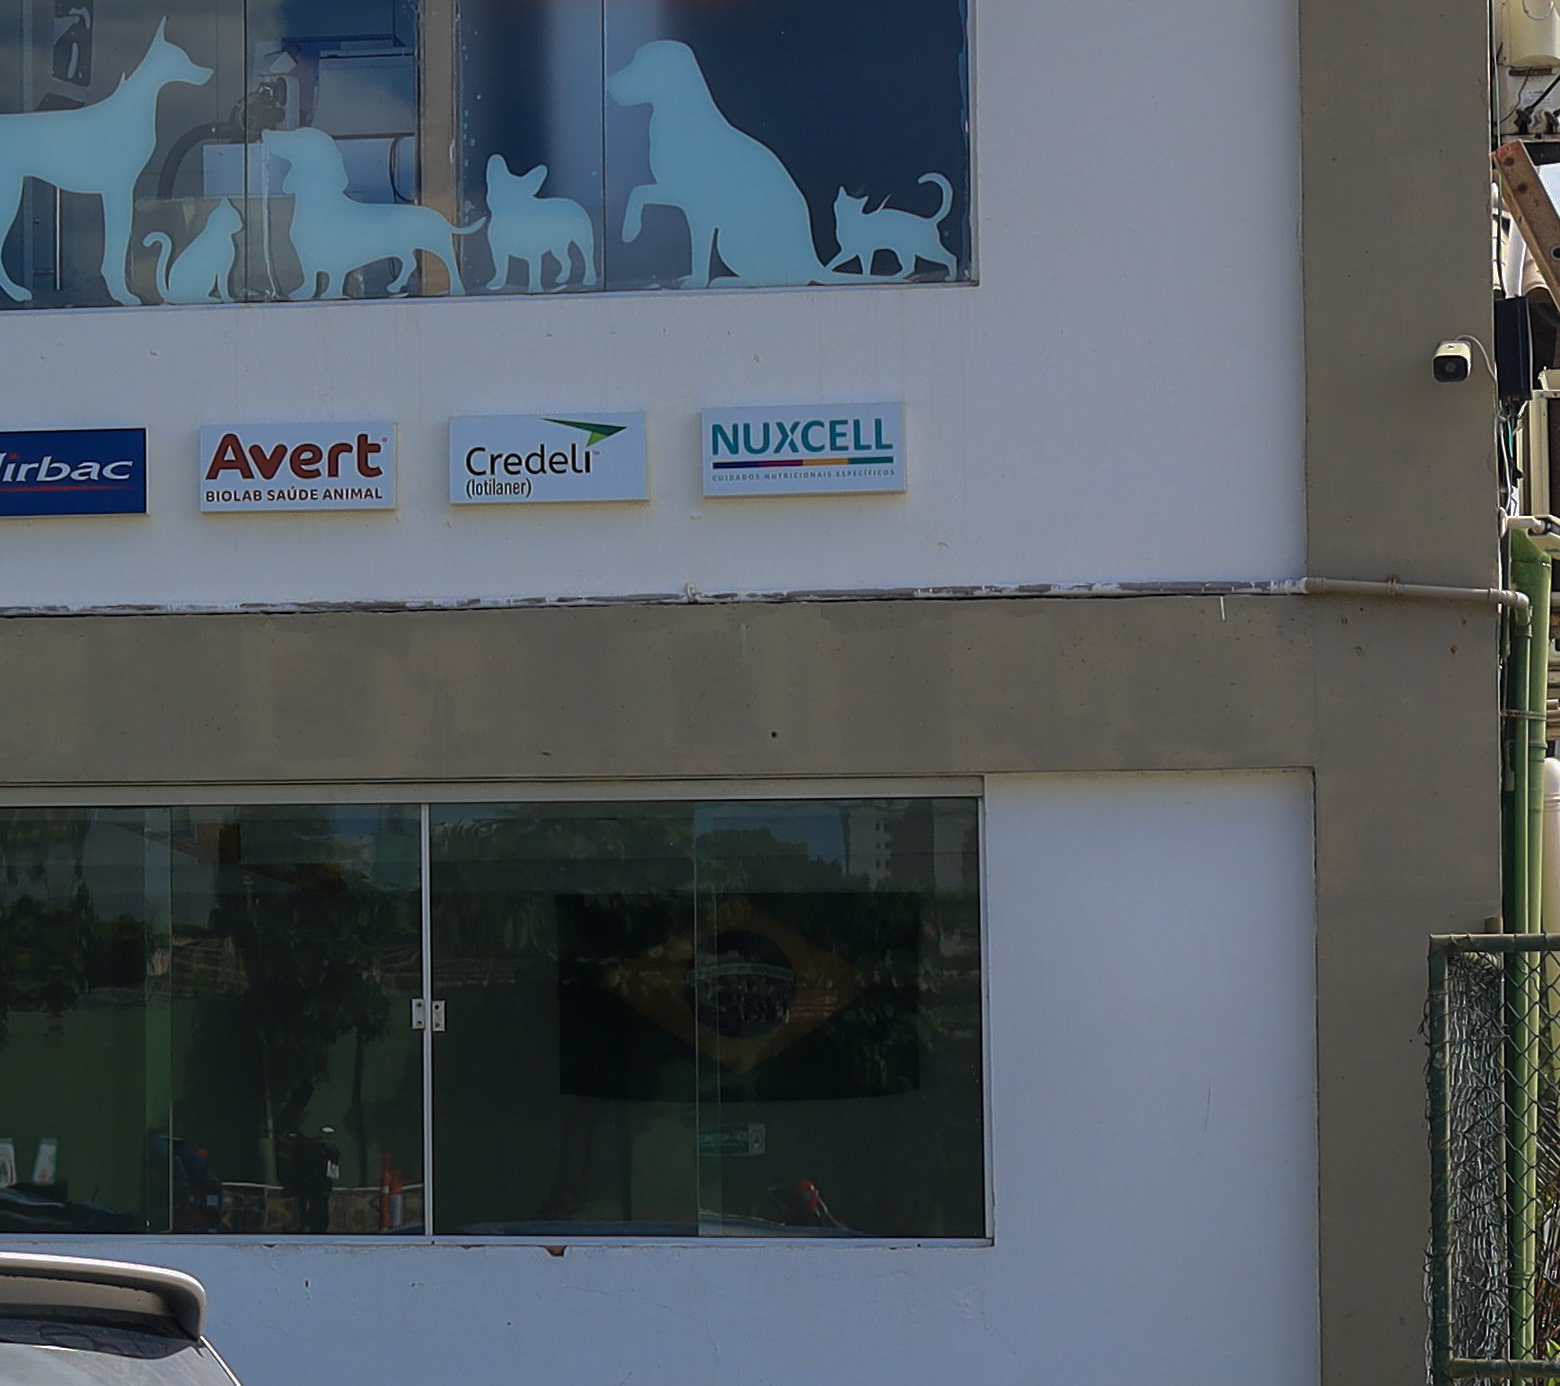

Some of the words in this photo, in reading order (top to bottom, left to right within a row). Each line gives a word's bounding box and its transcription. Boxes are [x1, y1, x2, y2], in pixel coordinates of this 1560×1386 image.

[711, 418, 894, 456] NUXCELL
[205, 433, 384, 480] Avert
[711, 473, 761, 482] CUIDADOS
[764, 470, 833, 481] NUTRICIONAIS
[205, 489, 263, 503] BIOLAB
[266, 486, 319, 502] SAÚDE
[322, 488, 383, 501] ANIMAL
[465, 478, 532, 499] (lotilaner)
